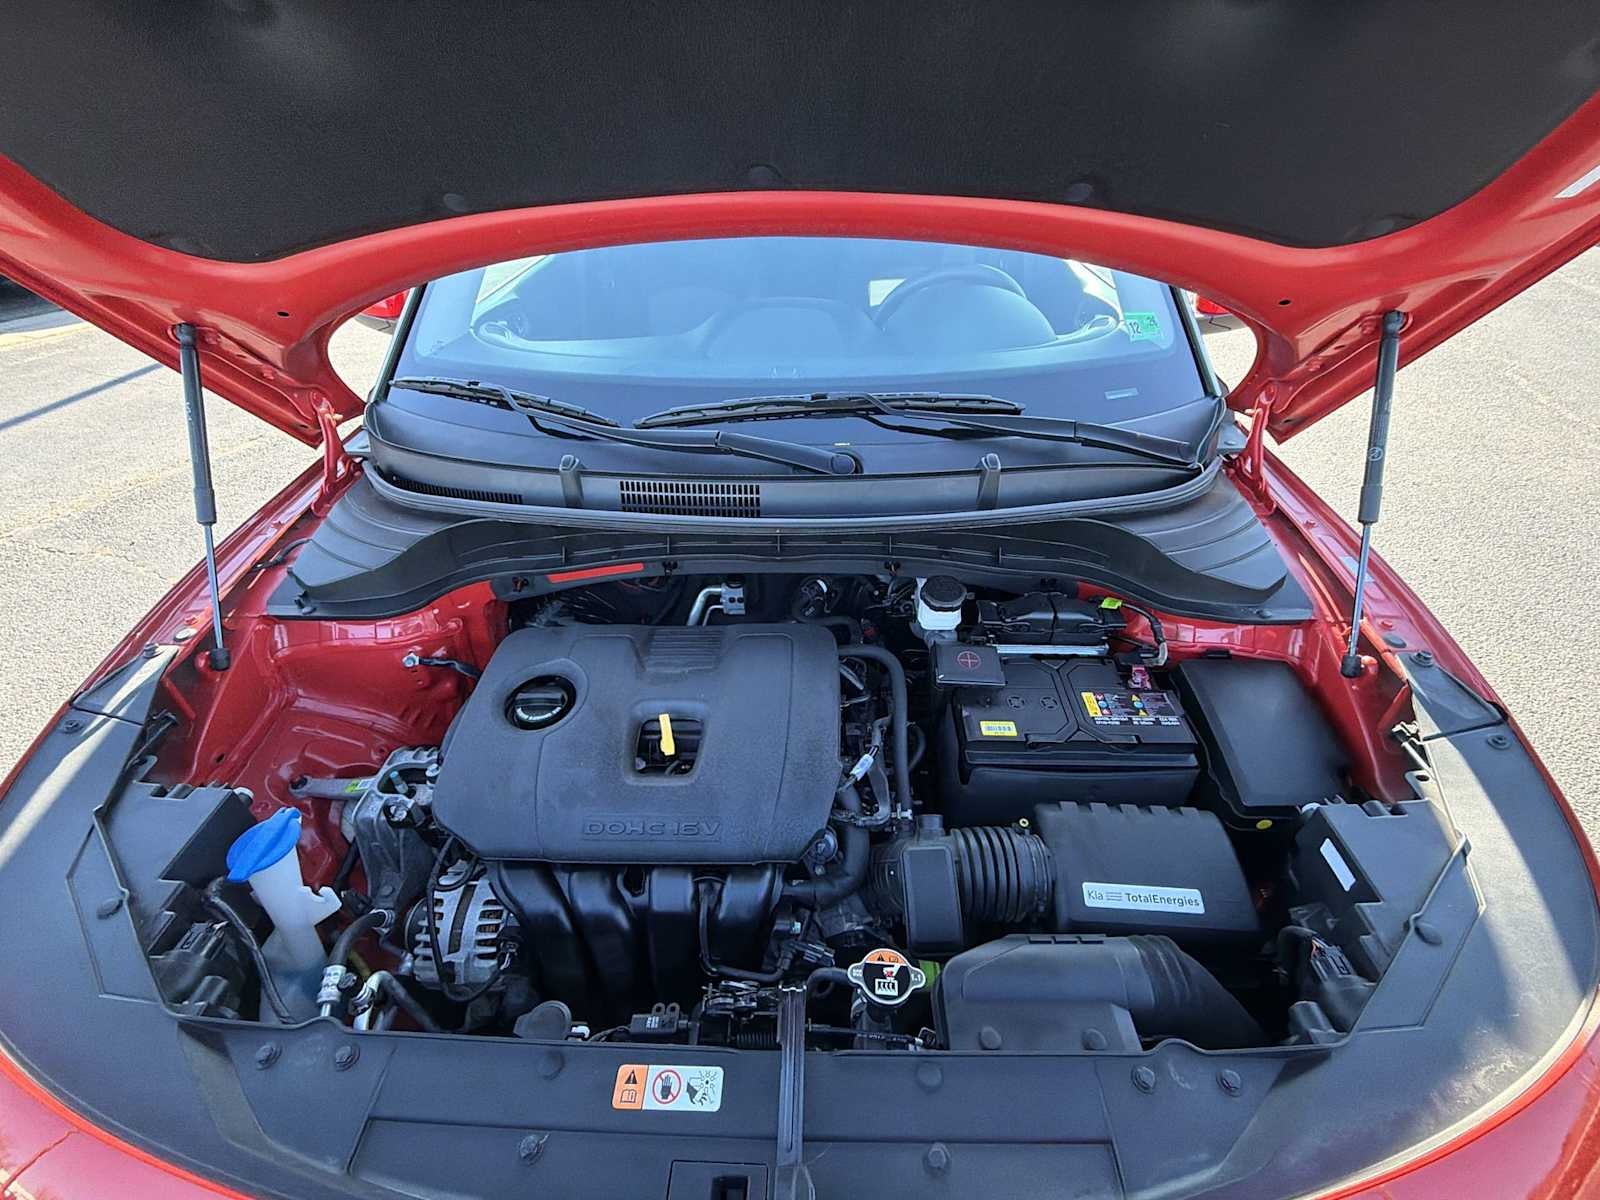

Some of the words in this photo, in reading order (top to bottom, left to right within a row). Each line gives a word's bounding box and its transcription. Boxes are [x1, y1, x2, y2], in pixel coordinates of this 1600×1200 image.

[1129, 321, 1141, 334] 12
[583, 821, 666, 836] DOHC
[672, 821, 721, 836] 16V
[1124, 892, 1200, 908] TotalEnergies
